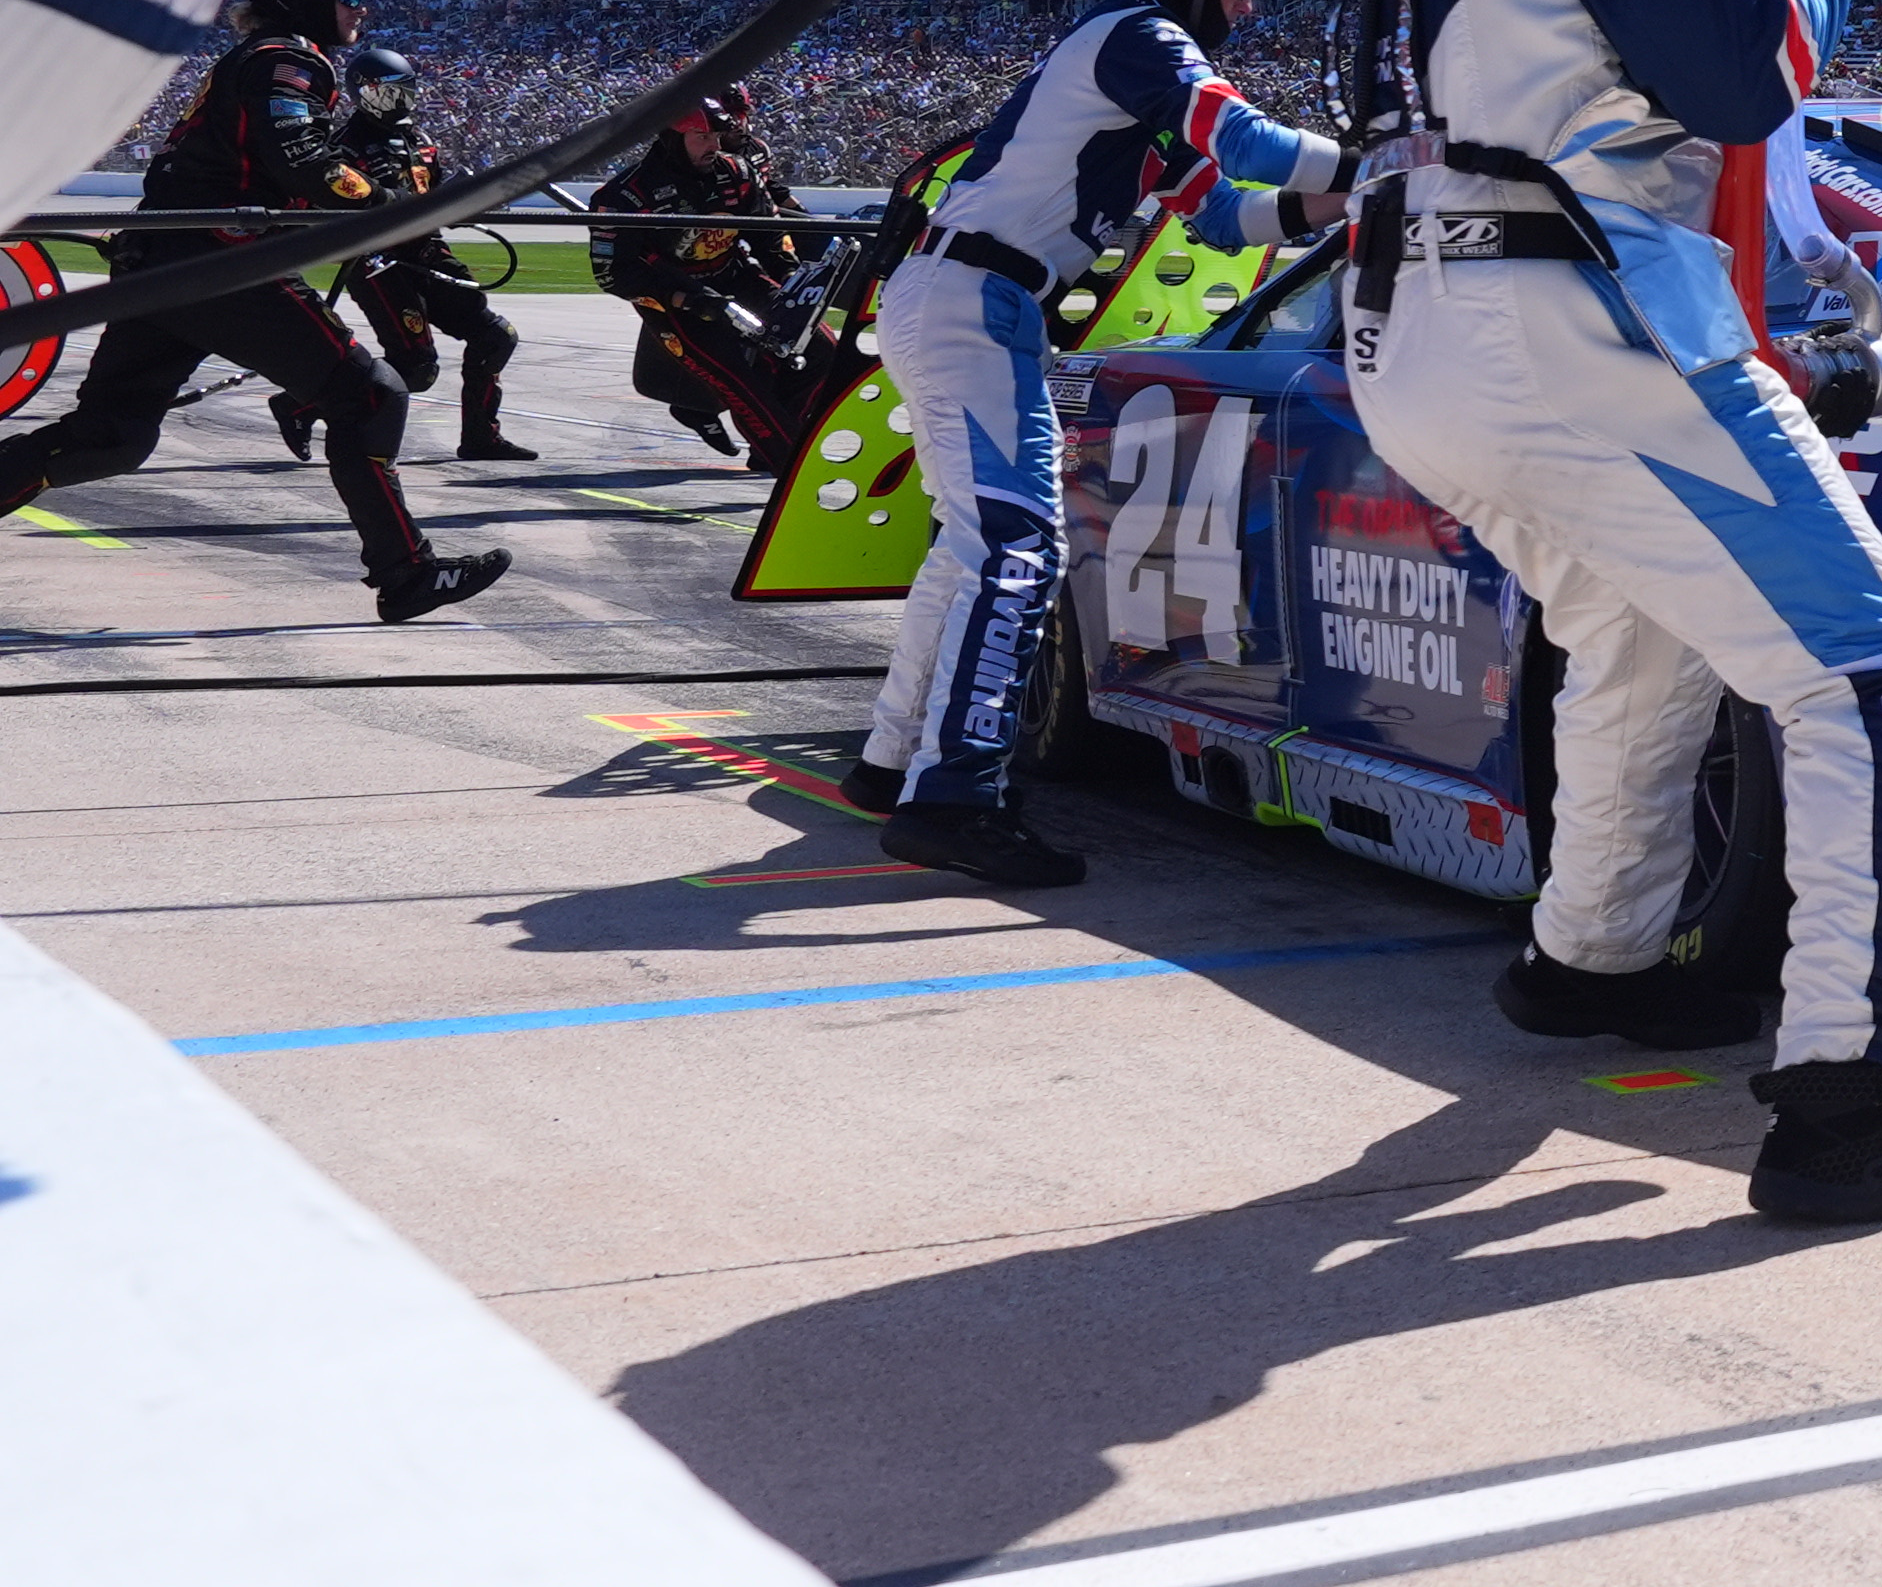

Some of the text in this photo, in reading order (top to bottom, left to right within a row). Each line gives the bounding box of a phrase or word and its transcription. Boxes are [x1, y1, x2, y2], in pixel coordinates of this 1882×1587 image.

[1407, 242, 1498, 255] MECNIX WEAR
[797, 286, 825, 306] 3
[1354, 328, 1380, 359] S
[1107, 383, 1254, 667] 24
[434, 568, 462, 591] N
[1311, 544, 1469, 628] HEAVY DUTY
[966, 530, 1045, 741] Valvoline
[1321, 611, 1416, 685] ENGINE
[1419, 629, 1463, 697] OIL
